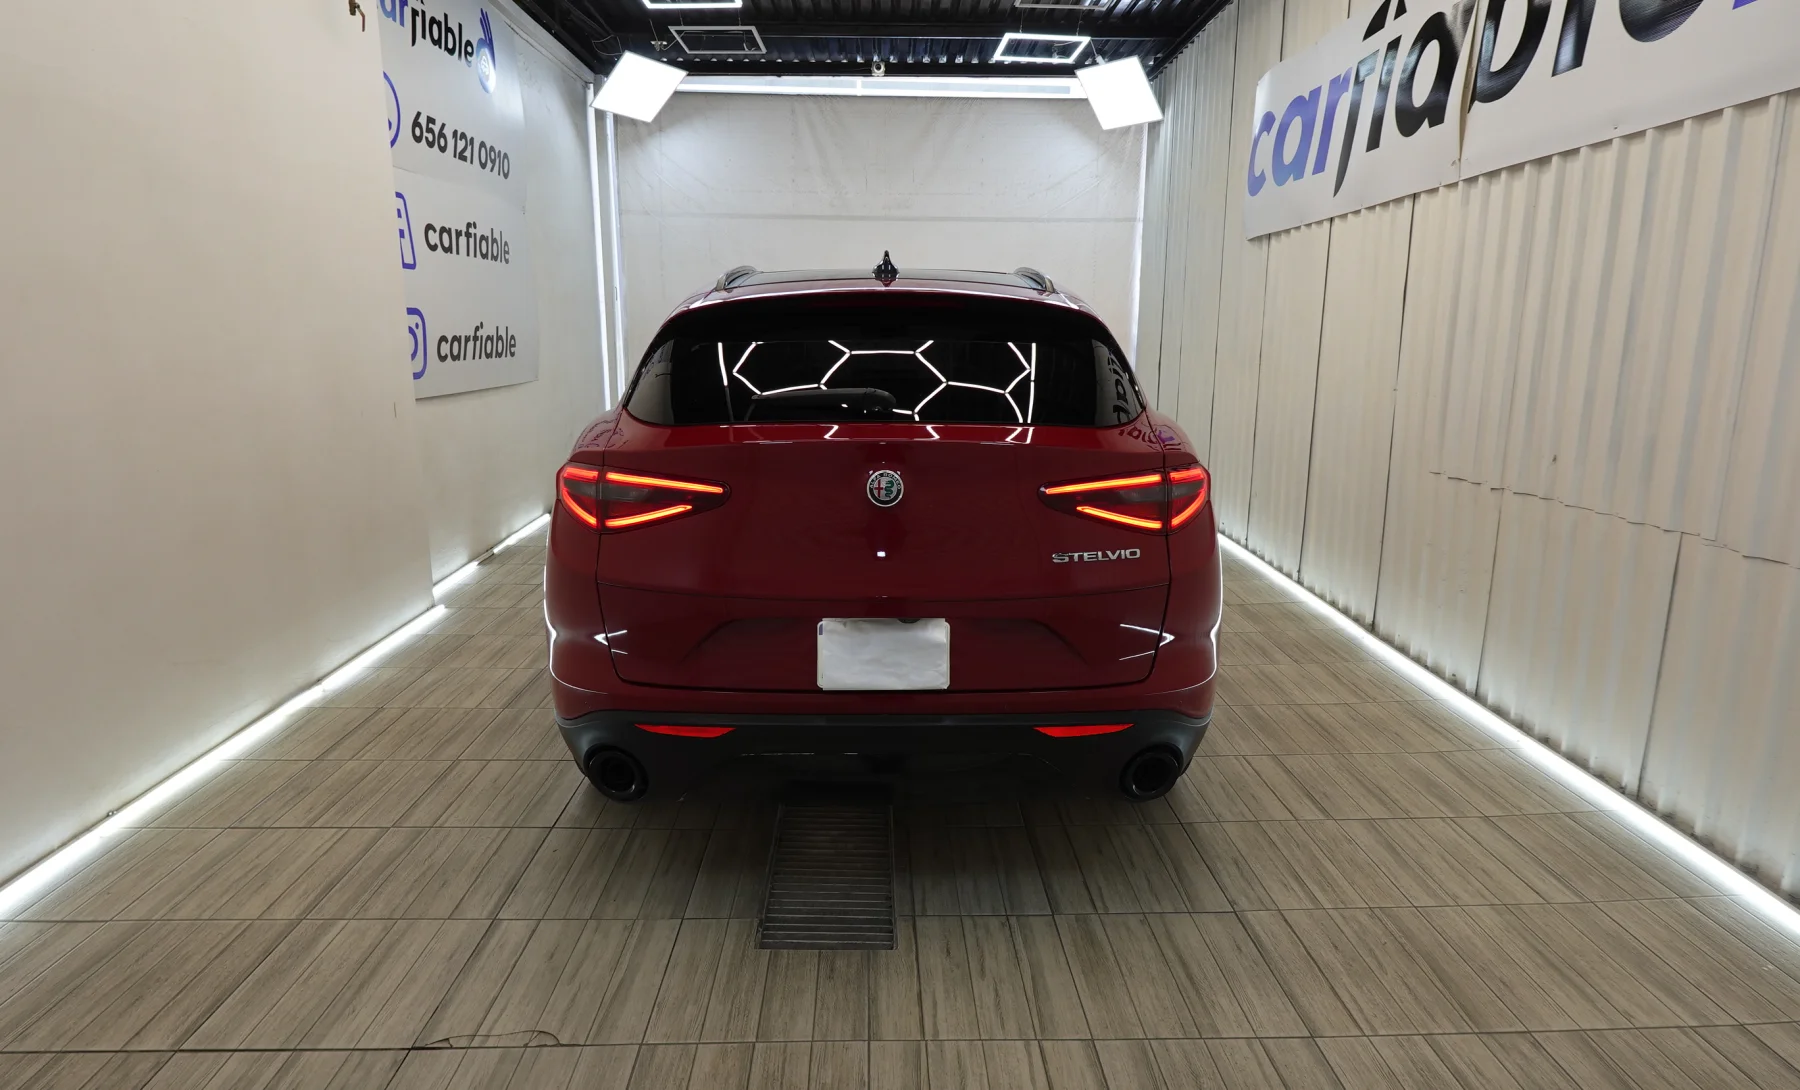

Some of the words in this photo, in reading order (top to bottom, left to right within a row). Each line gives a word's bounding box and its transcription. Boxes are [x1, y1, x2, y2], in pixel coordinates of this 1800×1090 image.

[379, 0, 474, 67] arfiable
[411, 111, 448, 153] 656
[452, 129, 474, 164] 121
[478, 141, 510, 179] 0910
[424, 221, 510, 264] carfiable
[436, 321, 516, 363] carfiable
[1052, 548, 1141, 563] STELVIO
